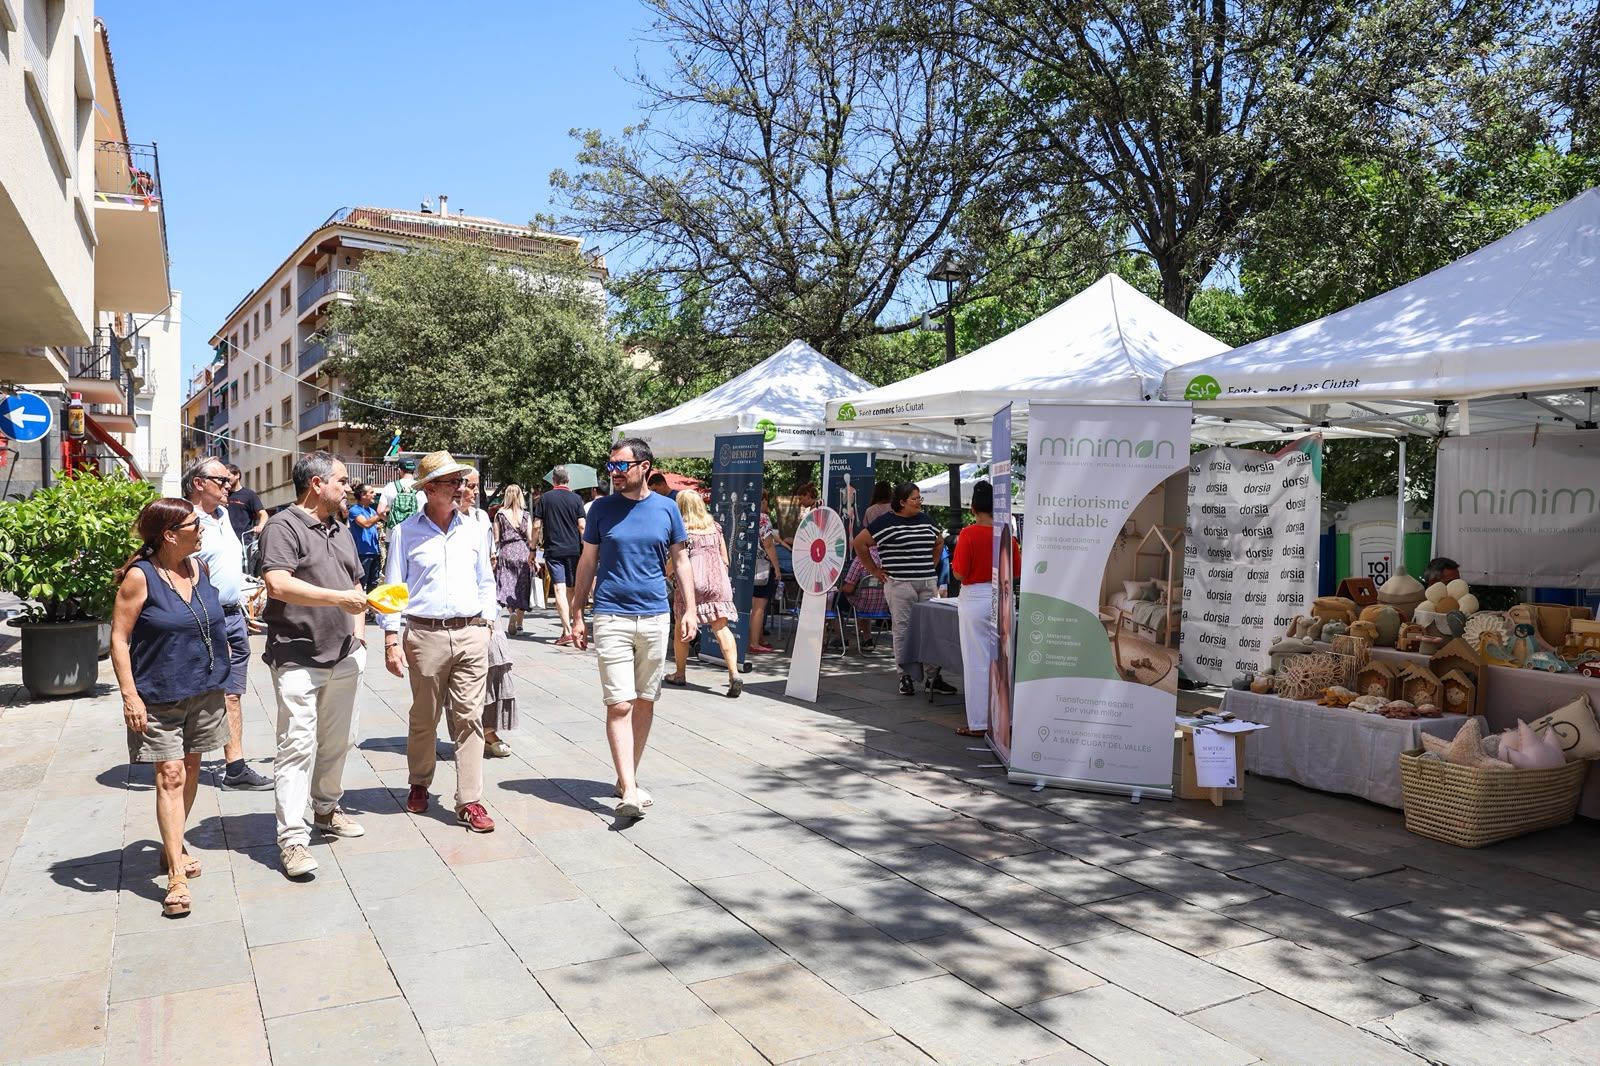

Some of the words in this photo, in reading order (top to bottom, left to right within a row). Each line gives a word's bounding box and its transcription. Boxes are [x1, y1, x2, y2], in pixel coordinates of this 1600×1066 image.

[1321, 378, 1360, 390] Ciutat
[872, 407, 895, 417] comerç
[905, 402, 924, 412] Ciutat
[792, 428, 817, 436] comerç
[1244, 461, 1275, 473] dorsia
[1206, 482, 1228, 494] dosia
[1243, 482, 1272, 494] dorsia
[1037, 493, 1130, 510] Interiorisme
[1458, 487, 1600, 515] minim
[1201, 503, 1226, 515] dorsia
[1239, 504, 1269, 515] dorsia
[1035, 513, 1109, 528] saludable
[1203, 525, 1229, 537] dorsia
[1241, 525, 1273, 537] dorsia
[1207, 547, 1232, 558] dorsia
[1245, 547, 1274, 559] dorsia
[1208, 567, 1233, 579] dorsia
[1206, 588, 1232, 601] dorsia
[1276, 590, 1305, 603] dorsia
[1203, 610, 1230, 623] dorsia
[1241, 614, 1264, 626] dorsia
[1199, 632, 1227, 646] dorsia
[1238, 636, 1261, 649] dorsia
[1196, 654, 1223, 668] dorsia
[1235, 658, 1258, 672] dorsia
[1055, 695, 1106, 706] Transformem
[1100, 710, 1122, 718] millor
[1059, 737, 1080, 745] SANT
[1081, 739, 1107, 748] CUGAT
[1108, 742, 1122, 750] DEL
